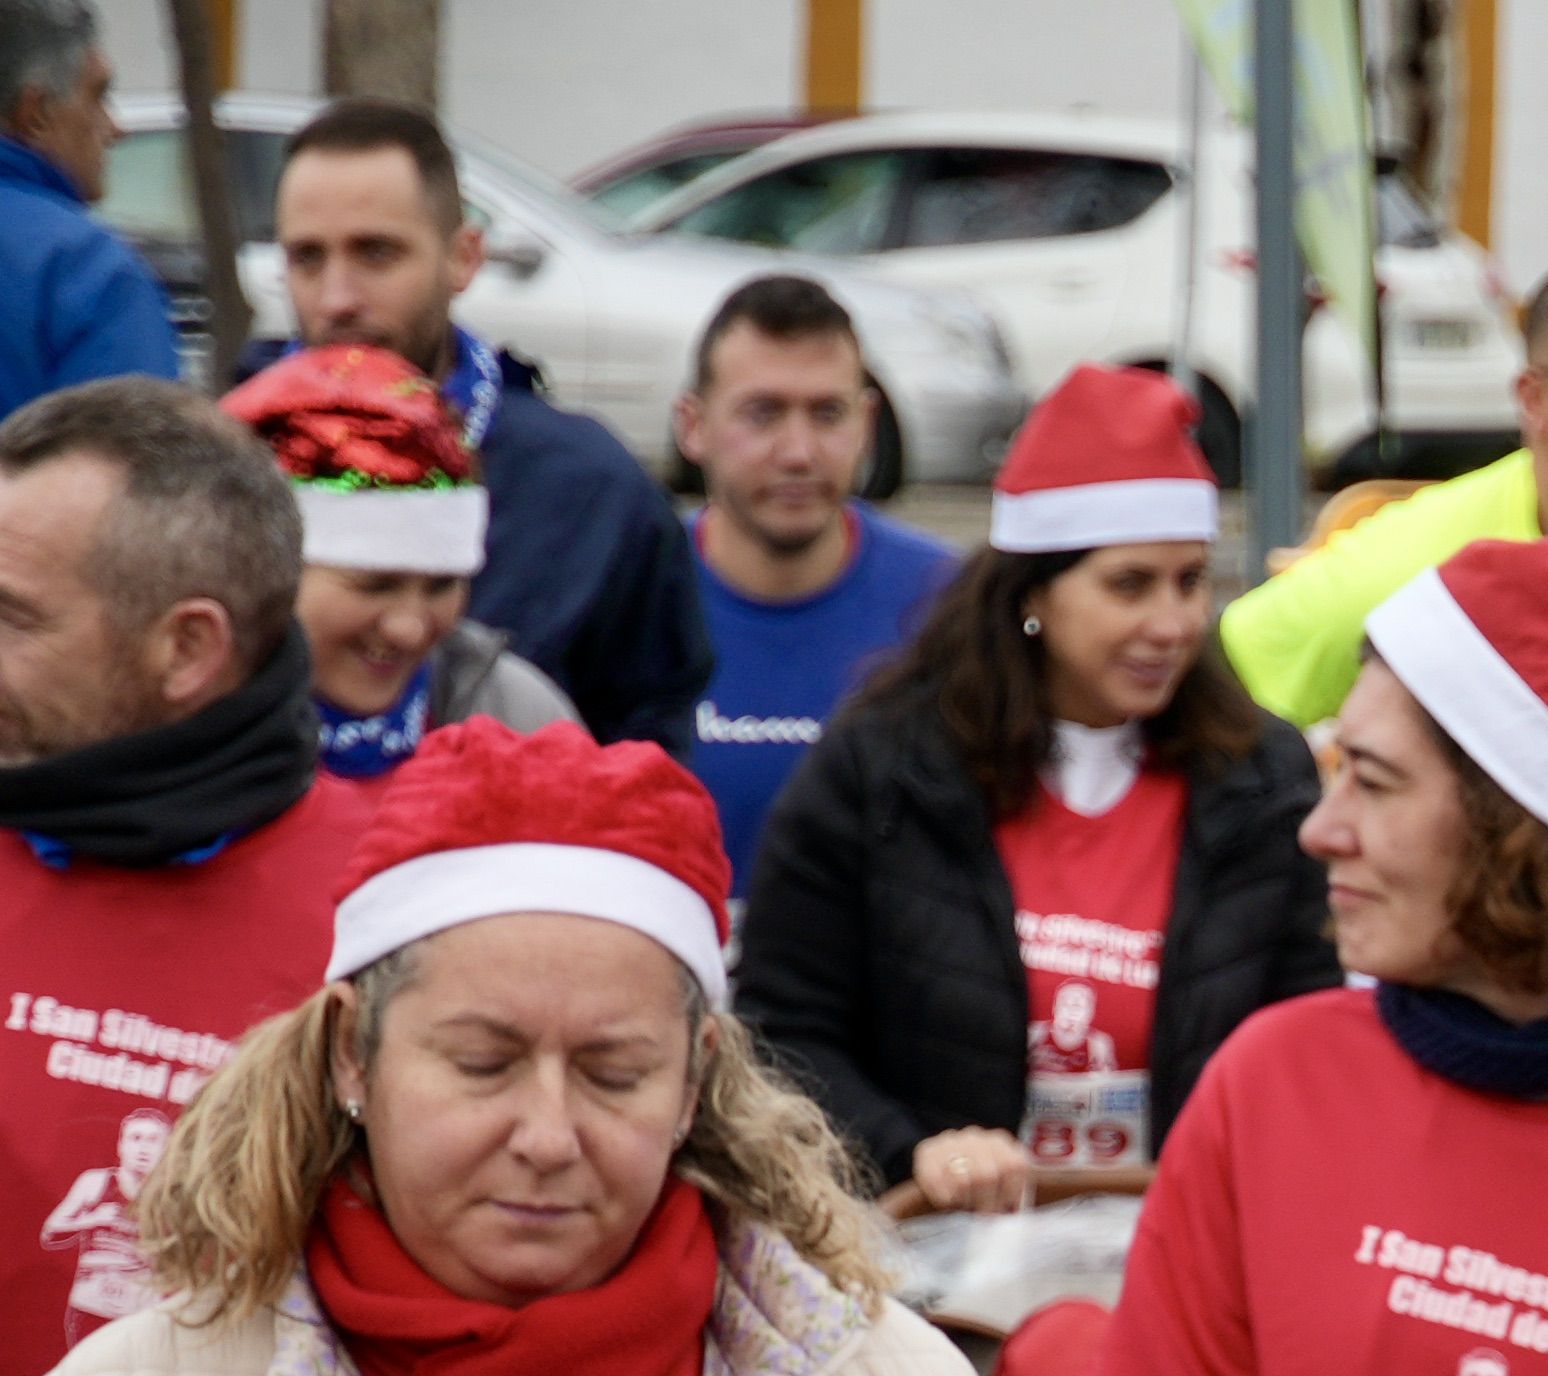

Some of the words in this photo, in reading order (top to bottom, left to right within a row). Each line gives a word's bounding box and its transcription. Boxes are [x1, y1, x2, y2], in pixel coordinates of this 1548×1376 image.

[29, 996, 98, 1043] San
[46, 1039, 170, 1100] Ciudad
[1354, 1225, 1383, 1265] I
[1378, 1229, 1446, 1280] San
[1387, 1273, 1515, 1342] Ciudad
